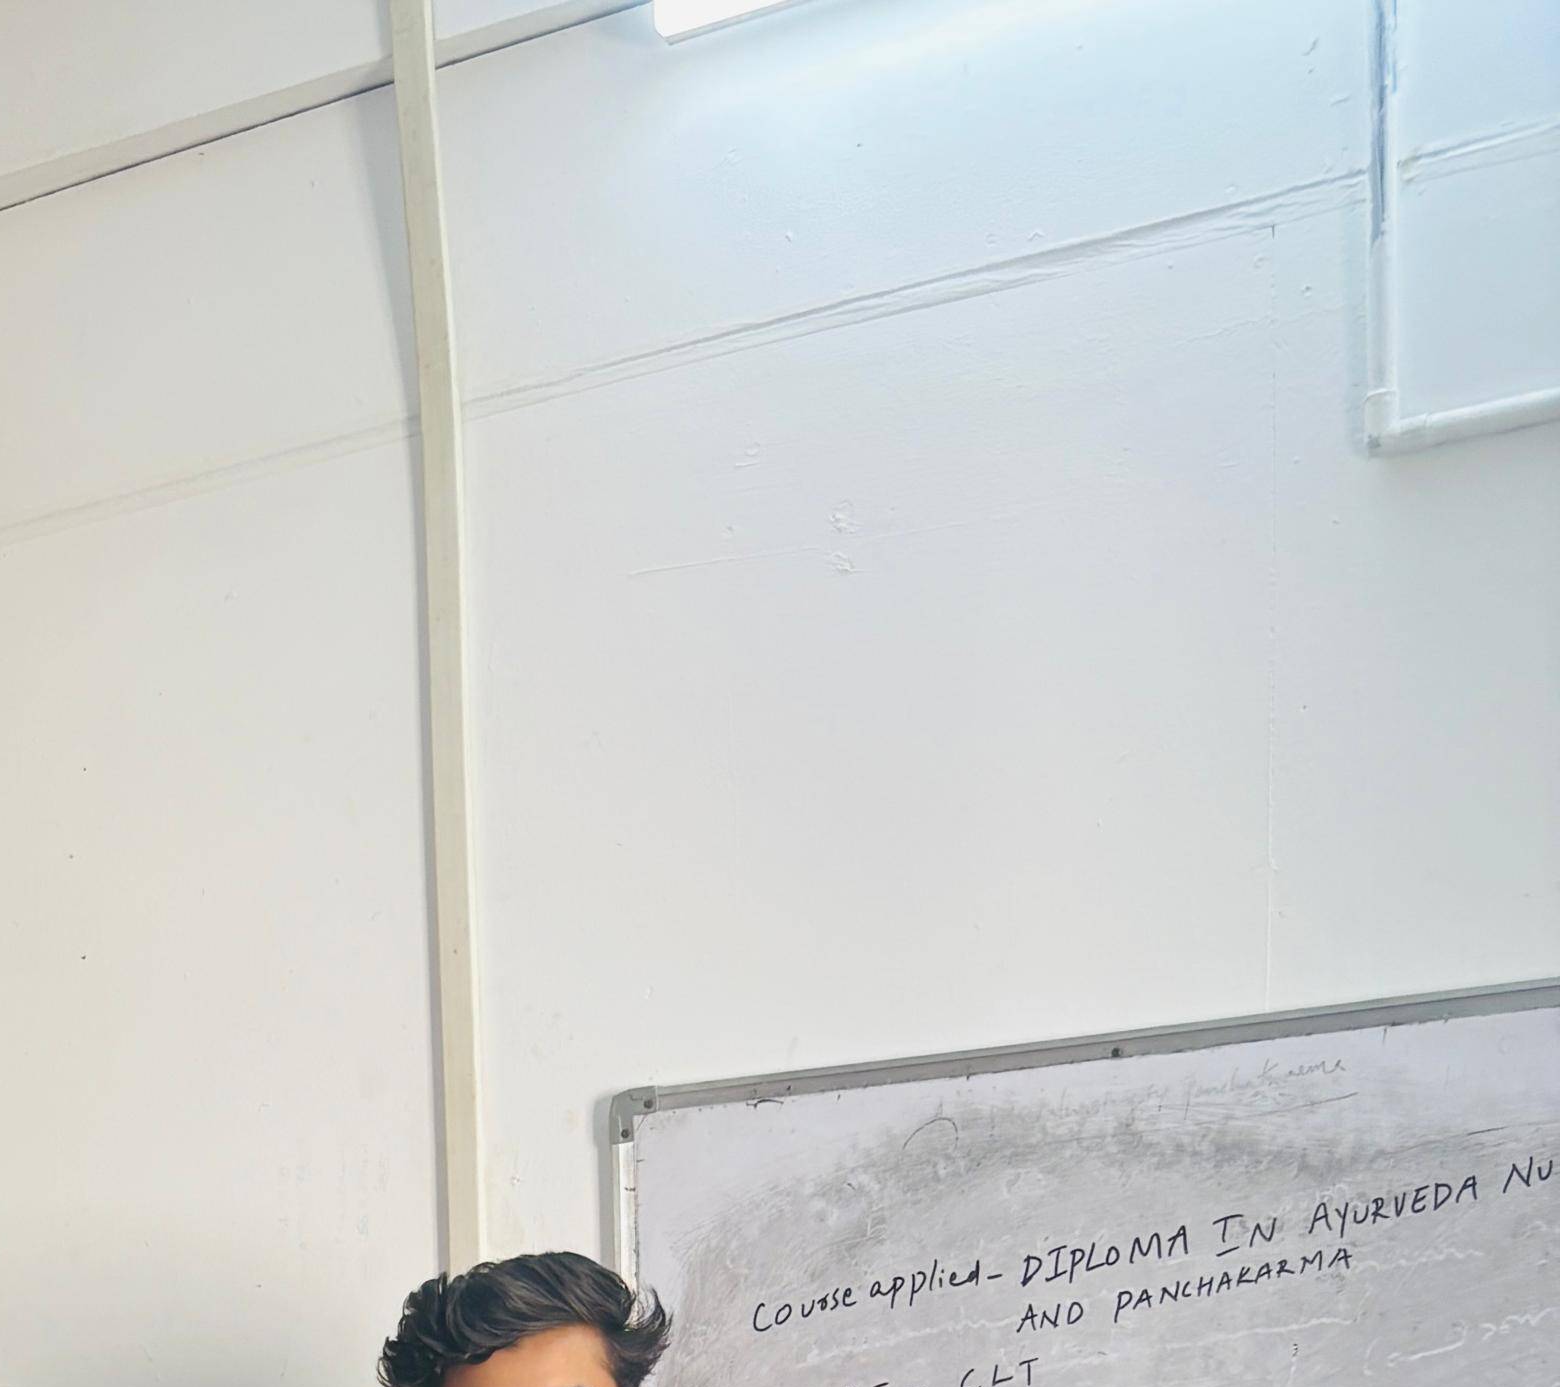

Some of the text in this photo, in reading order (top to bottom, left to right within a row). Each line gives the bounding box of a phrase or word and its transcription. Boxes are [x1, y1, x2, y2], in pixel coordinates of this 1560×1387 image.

[1020, 1224, 1189, 1288] DIPLOMA
[1211, 1213, 1278, 1258] IN
[1307, 1174, 1478, 1239] AYURVEDA
[1015, 1247, 1353, 1334] AND PANCHAKARMA
